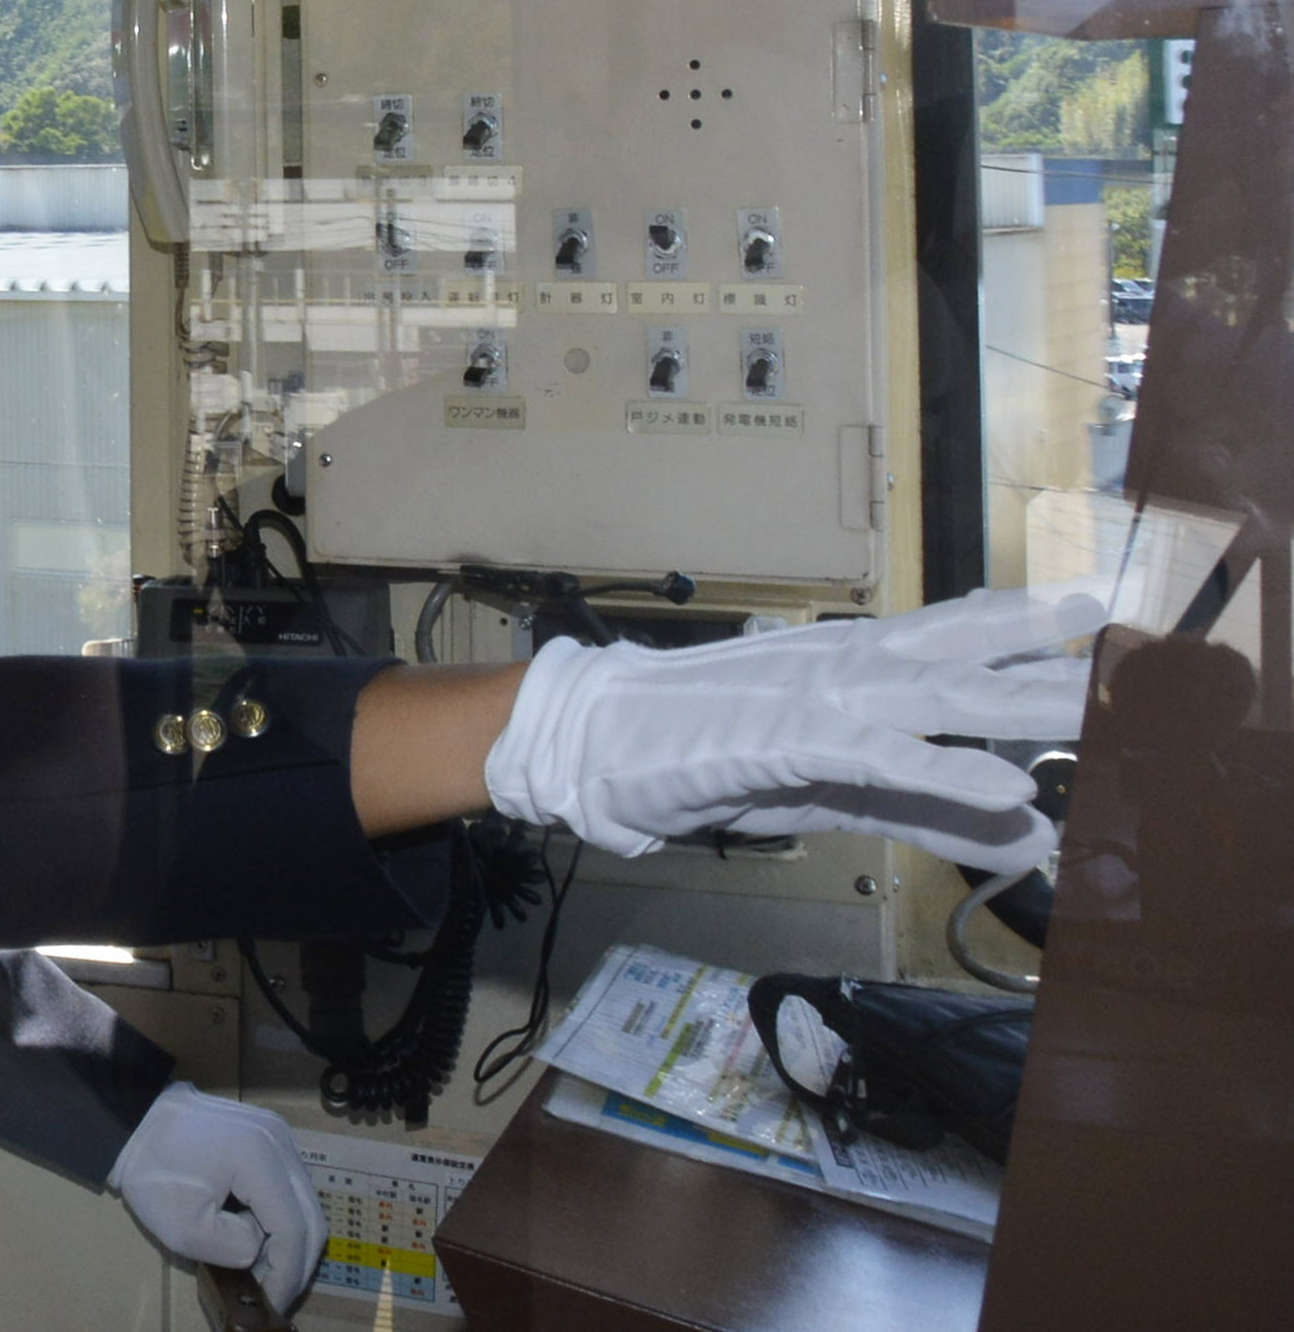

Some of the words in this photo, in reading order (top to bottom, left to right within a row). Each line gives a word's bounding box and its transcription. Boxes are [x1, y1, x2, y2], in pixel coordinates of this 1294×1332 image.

[654, 213, 675, 225] ON
[747, 214, 768, 225] ON
[384, 259, 409, 271] OFF
[653, 263, 679, 274] OFF
[630, 292, 705, 306] 室内灯
[278, 632, 320, 643] HITACHI
